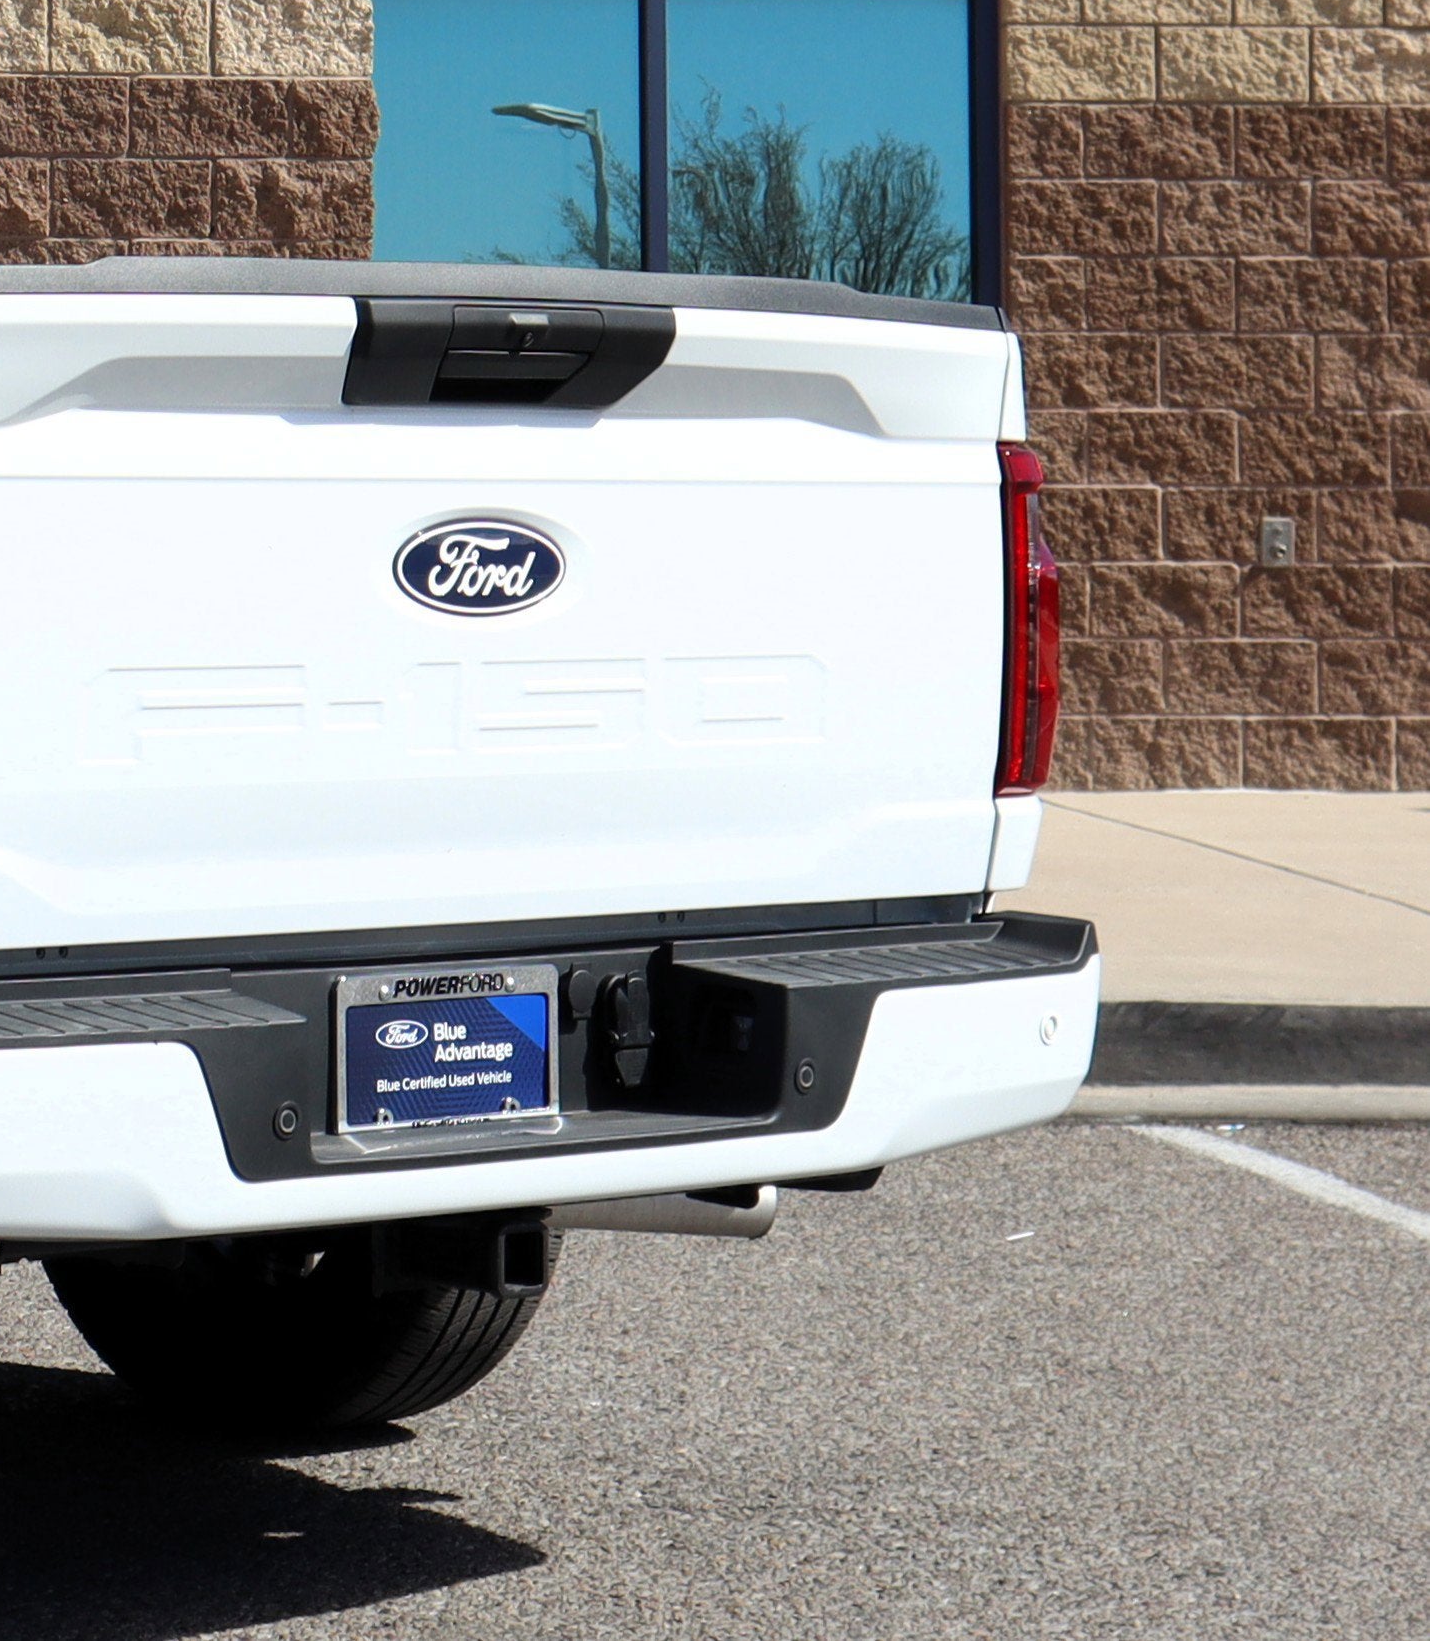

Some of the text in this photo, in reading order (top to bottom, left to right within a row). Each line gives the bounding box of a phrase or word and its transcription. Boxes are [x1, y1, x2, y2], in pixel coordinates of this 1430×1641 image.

[427, 533, 537, 598] Ford
[393, 973, 503, 997] POWERFORD
[385, 1024, 417, 1044] Ford
[433, 1022, 466, 1041] Blue
[434, 1041, 513, 1062] Advantage
[377, 1070, 512, 1093] Blue Certified Used Vehicle
